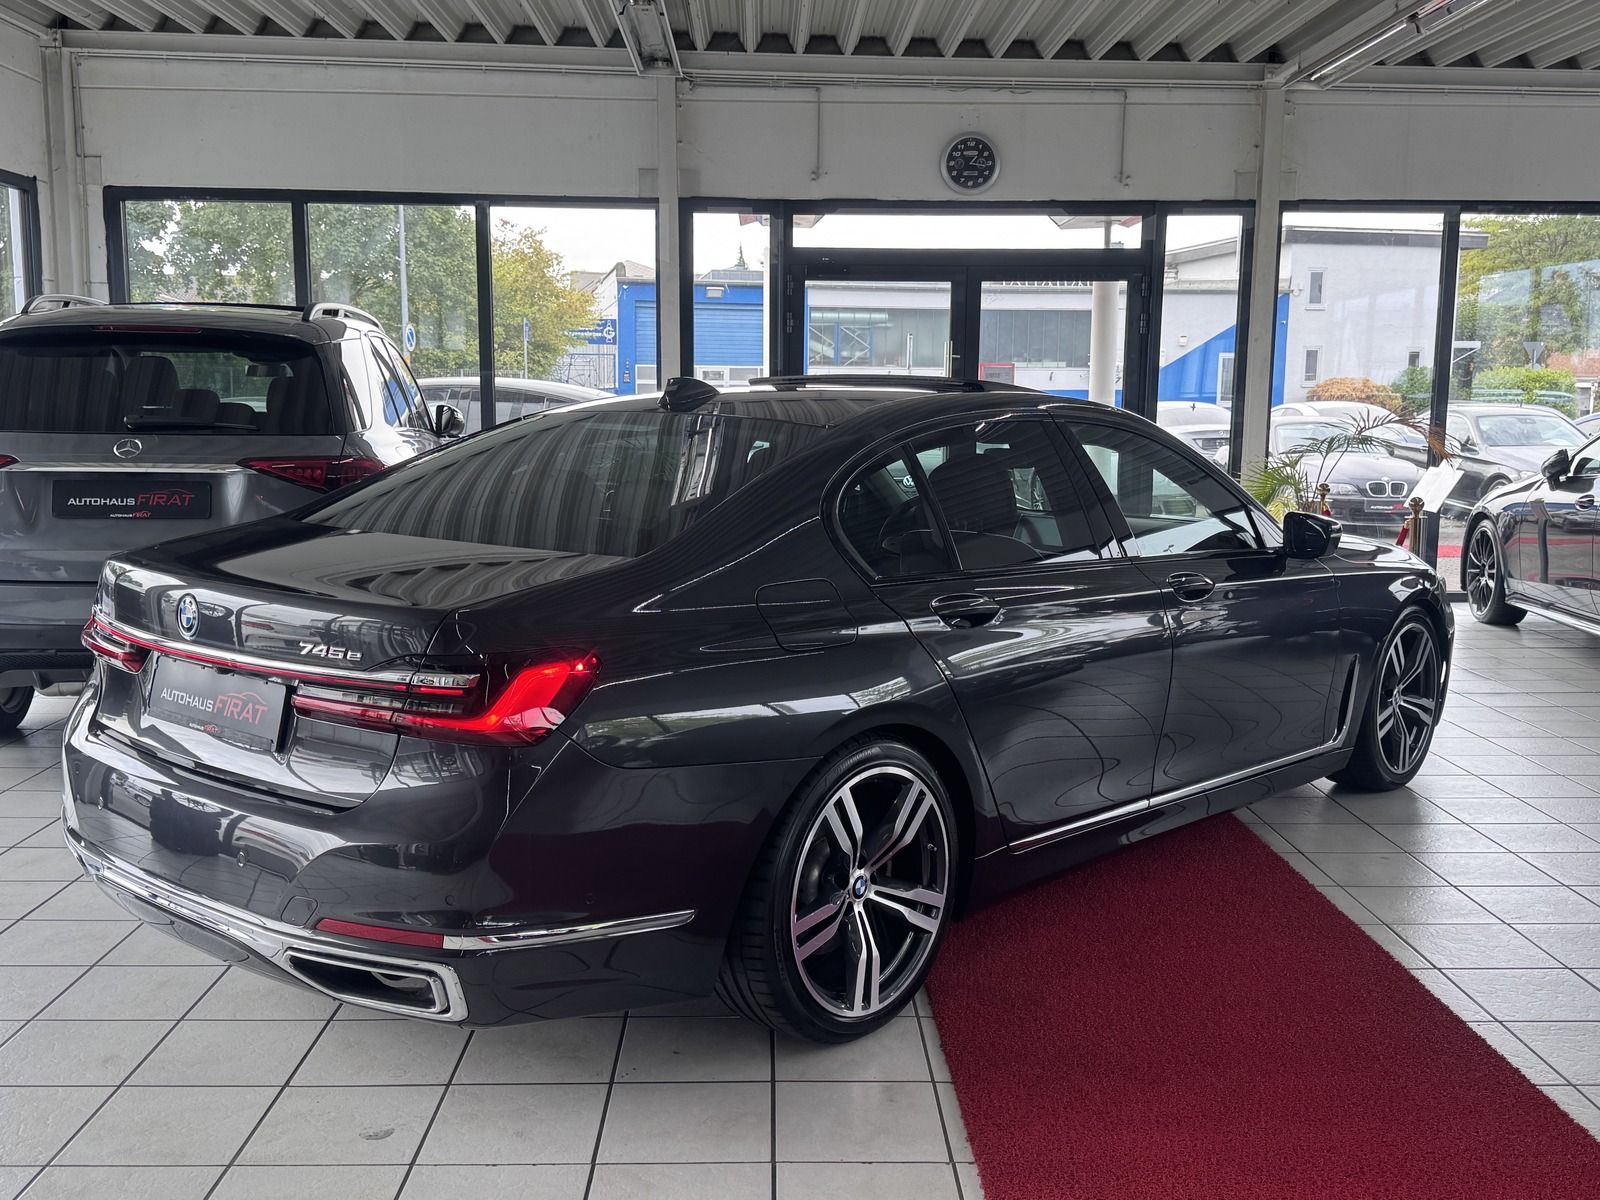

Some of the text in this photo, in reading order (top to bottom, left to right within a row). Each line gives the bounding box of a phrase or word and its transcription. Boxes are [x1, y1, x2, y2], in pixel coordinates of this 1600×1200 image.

[67, 494, 195, 507] AUTOHAUS FIRAT
[299, 641, 364, 662] 745e
[160, 687, 269, 725] AUTOHAUS FIRAT
